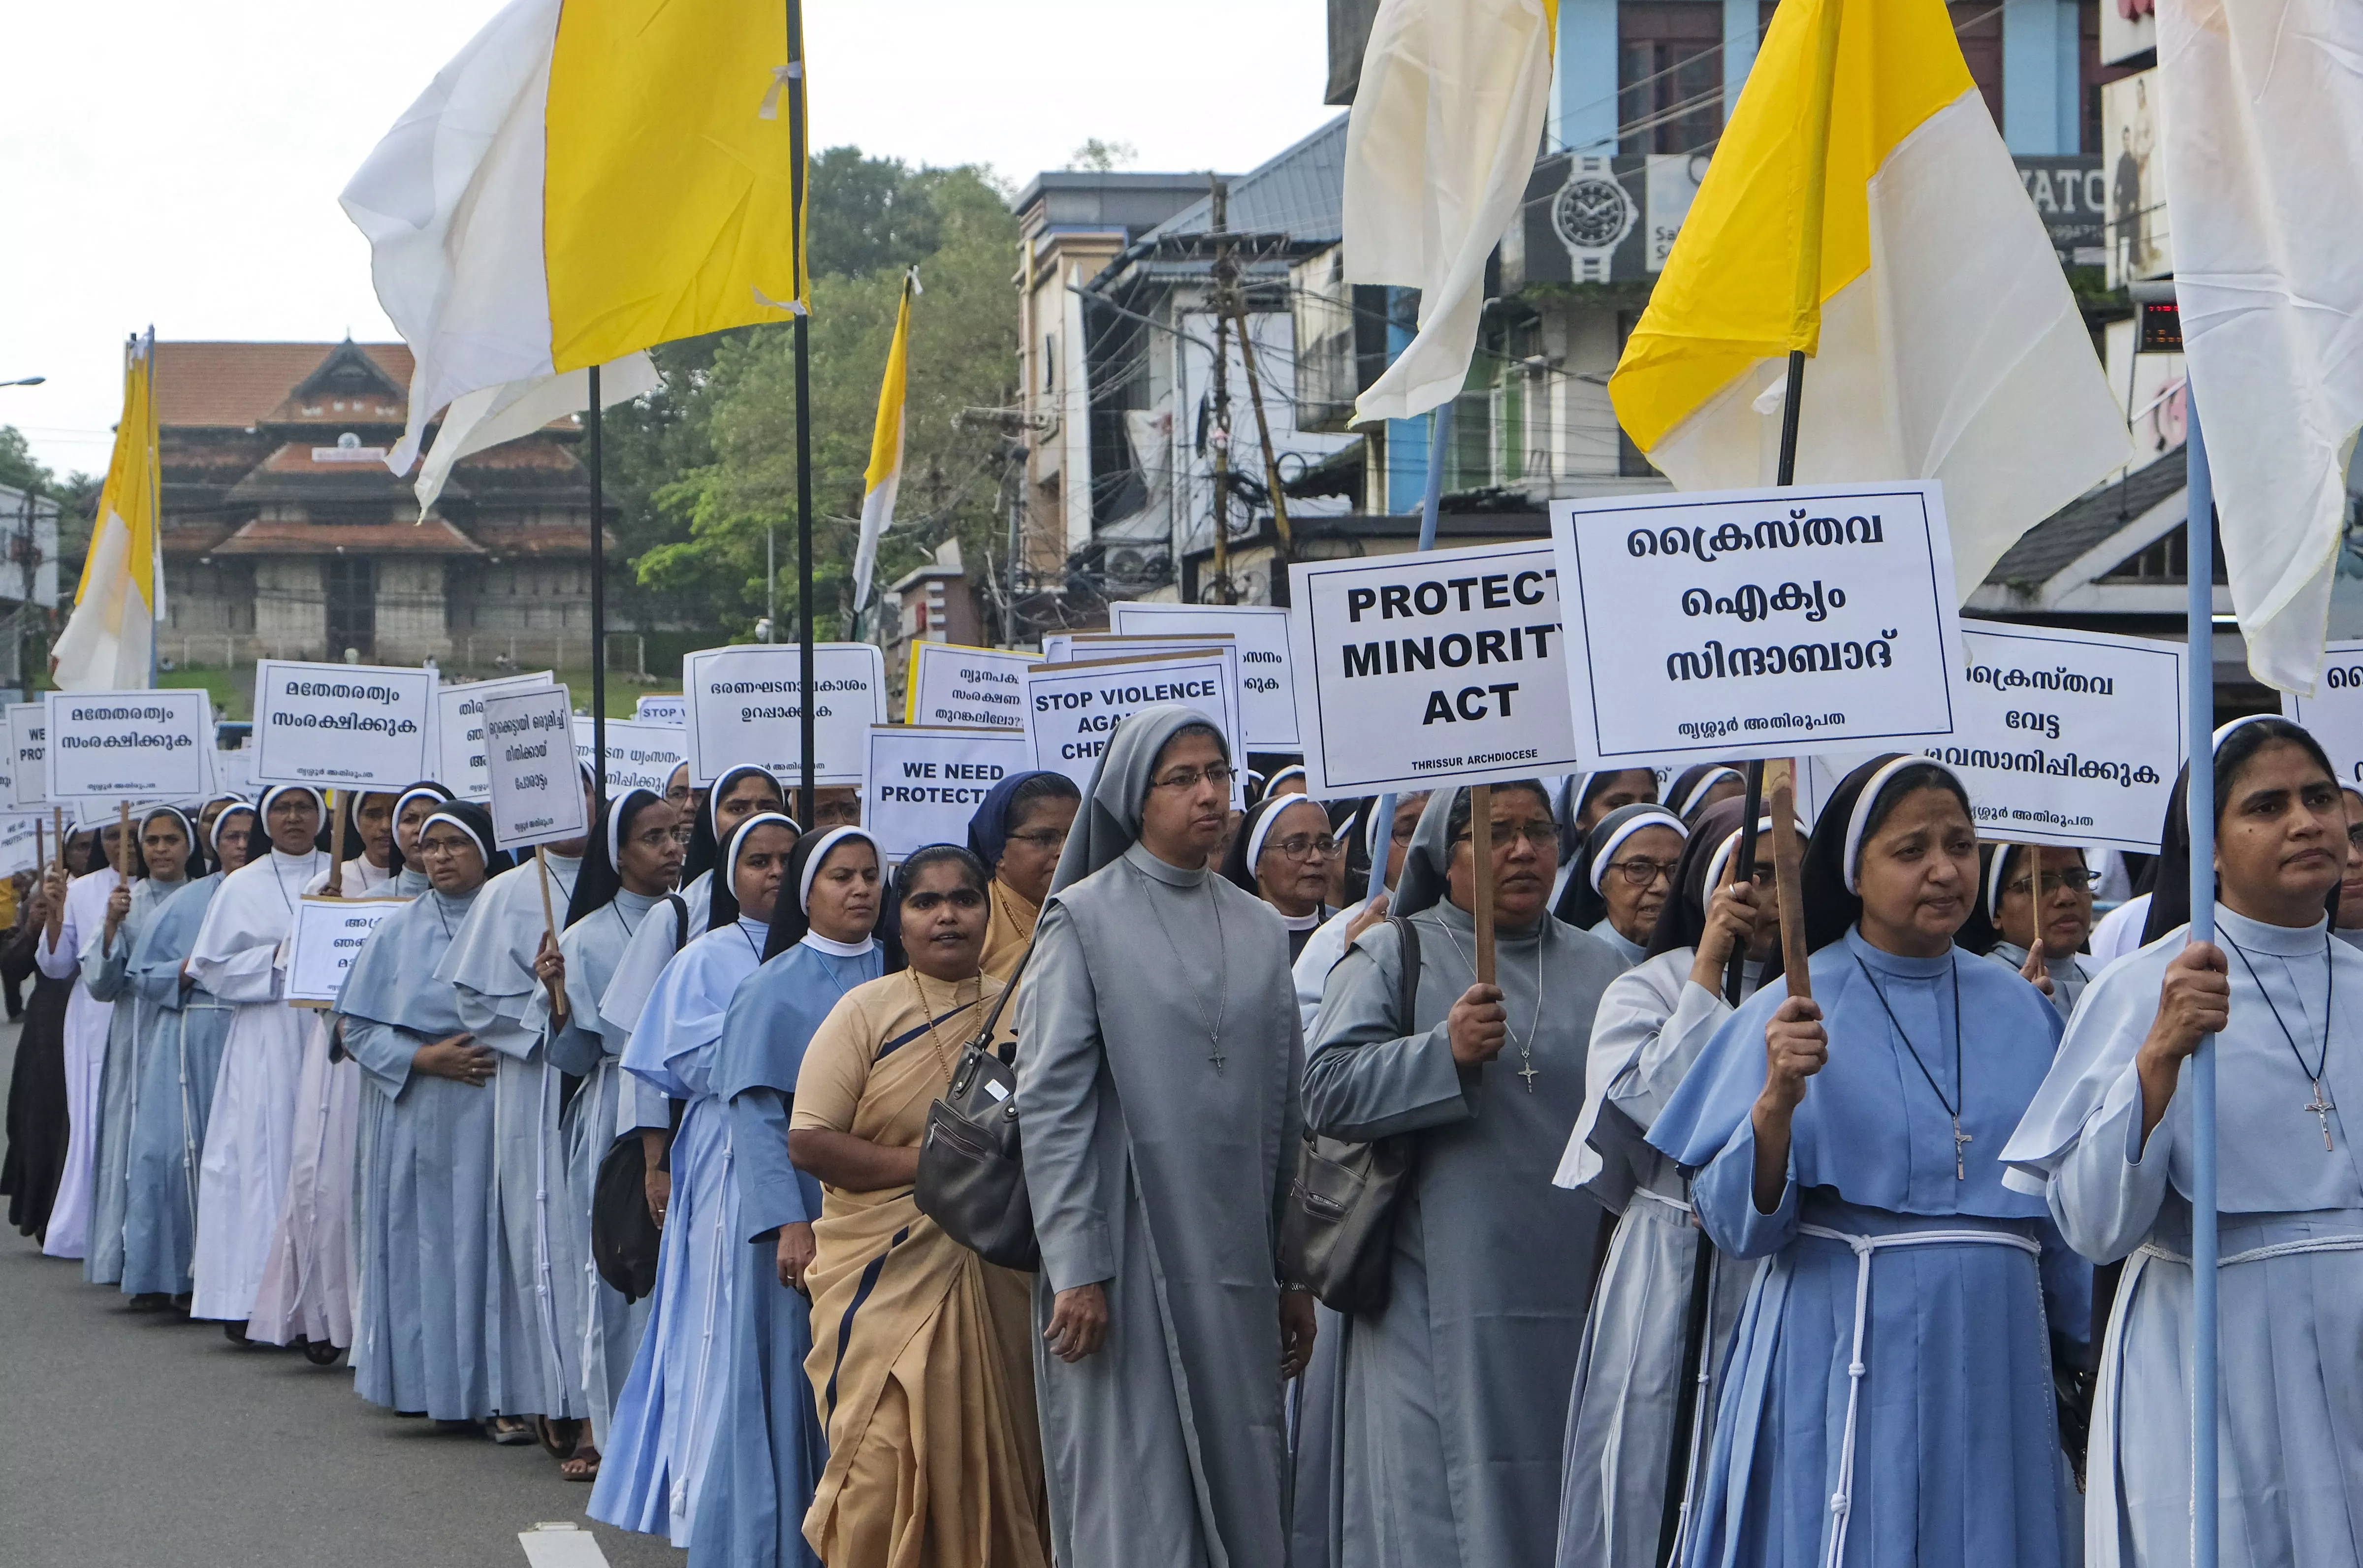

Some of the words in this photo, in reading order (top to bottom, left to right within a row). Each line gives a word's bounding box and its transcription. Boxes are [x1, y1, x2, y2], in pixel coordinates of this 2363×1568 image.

[1626, 506, 1884, 562] ക്രൈസ്തവ
[1682, 580, 1846, 622] ഐക്യം
[1342, 623, 1564, 678] MINORIT
[1666, 628, 1898, 681] സിന്ദാബാദ്
[286, 681, 400, 705] മതേതരത്വം
[952, 689, 1020, 705] സംരക്ഷണ
[1036, 691, 1093, 712] STOP
[1099, 680, 1216, 705] VIOLENCE
[1422, 682, 1519, 725] ACT
[71, 707, 174, 723] മതേതരത്വം
[272, 712, 417, 737] സംരക്ഷിക്കുക
[643, 708, 676, 717] STOP
[1744, 712, 1845, 731] അതിരൂപത
[2006, 710, 2060, 739] വേട്ട
[62, 731, 192, 751] സംരക്ഷിക്കുക
[903, 762, 937, 778] WE
[945, 764, 1005, 781] NEED
[1411, 757, 1465, 773] THRISSUR
[1468, 749, 1540, 767] ARCHDIOCESE
[2012, 810, 2093, 828] അതിരൂപത
